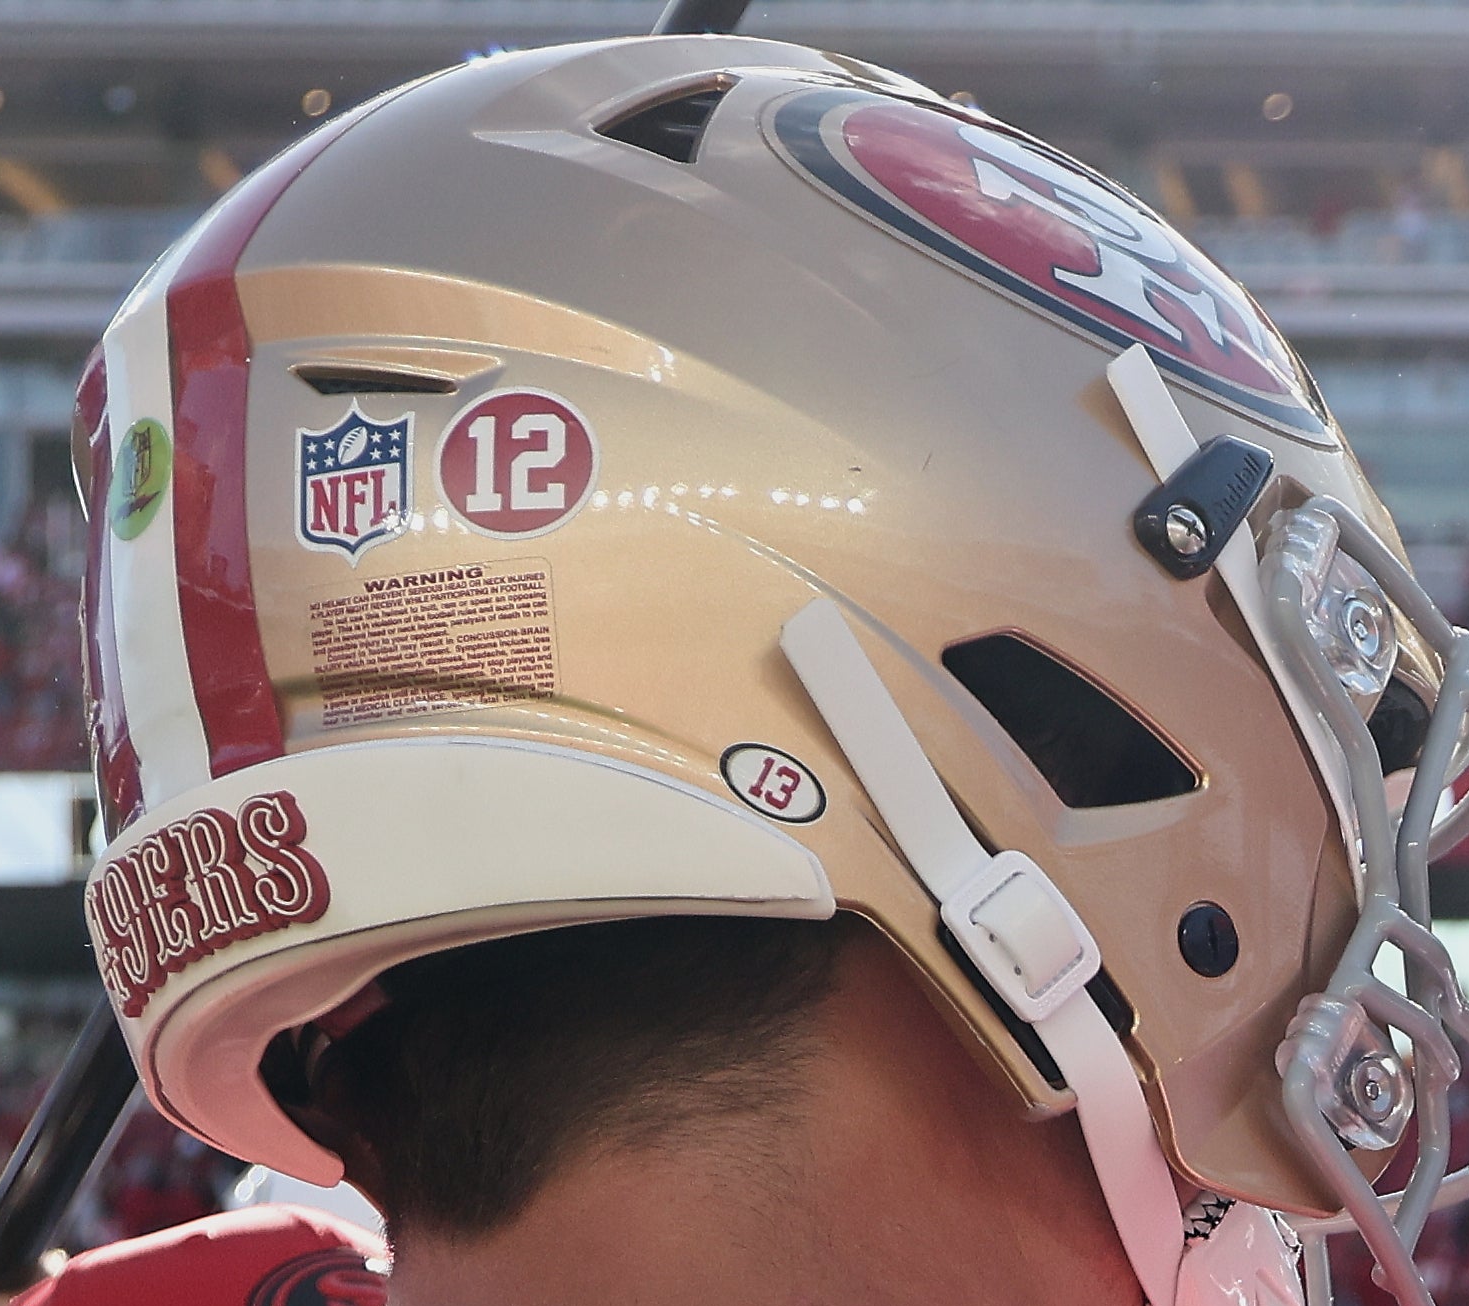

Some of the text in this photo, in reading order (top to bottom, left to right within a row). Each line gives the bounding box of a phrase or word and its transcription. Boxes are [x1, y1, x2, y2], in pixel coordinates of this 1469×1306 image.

[466, 413, 567, 512] 12
[310, 469, 397, 537] NFL
[364, 566, 484, 592] WARNING
[431, 586, 488, 601] PARTICIPATING
[445, 581, 467, 590] HEAD
[483, 576, 506, 586] NECK
[508, 572, 546, 583] INJURIES
[748, 757, 801, 810] 13
